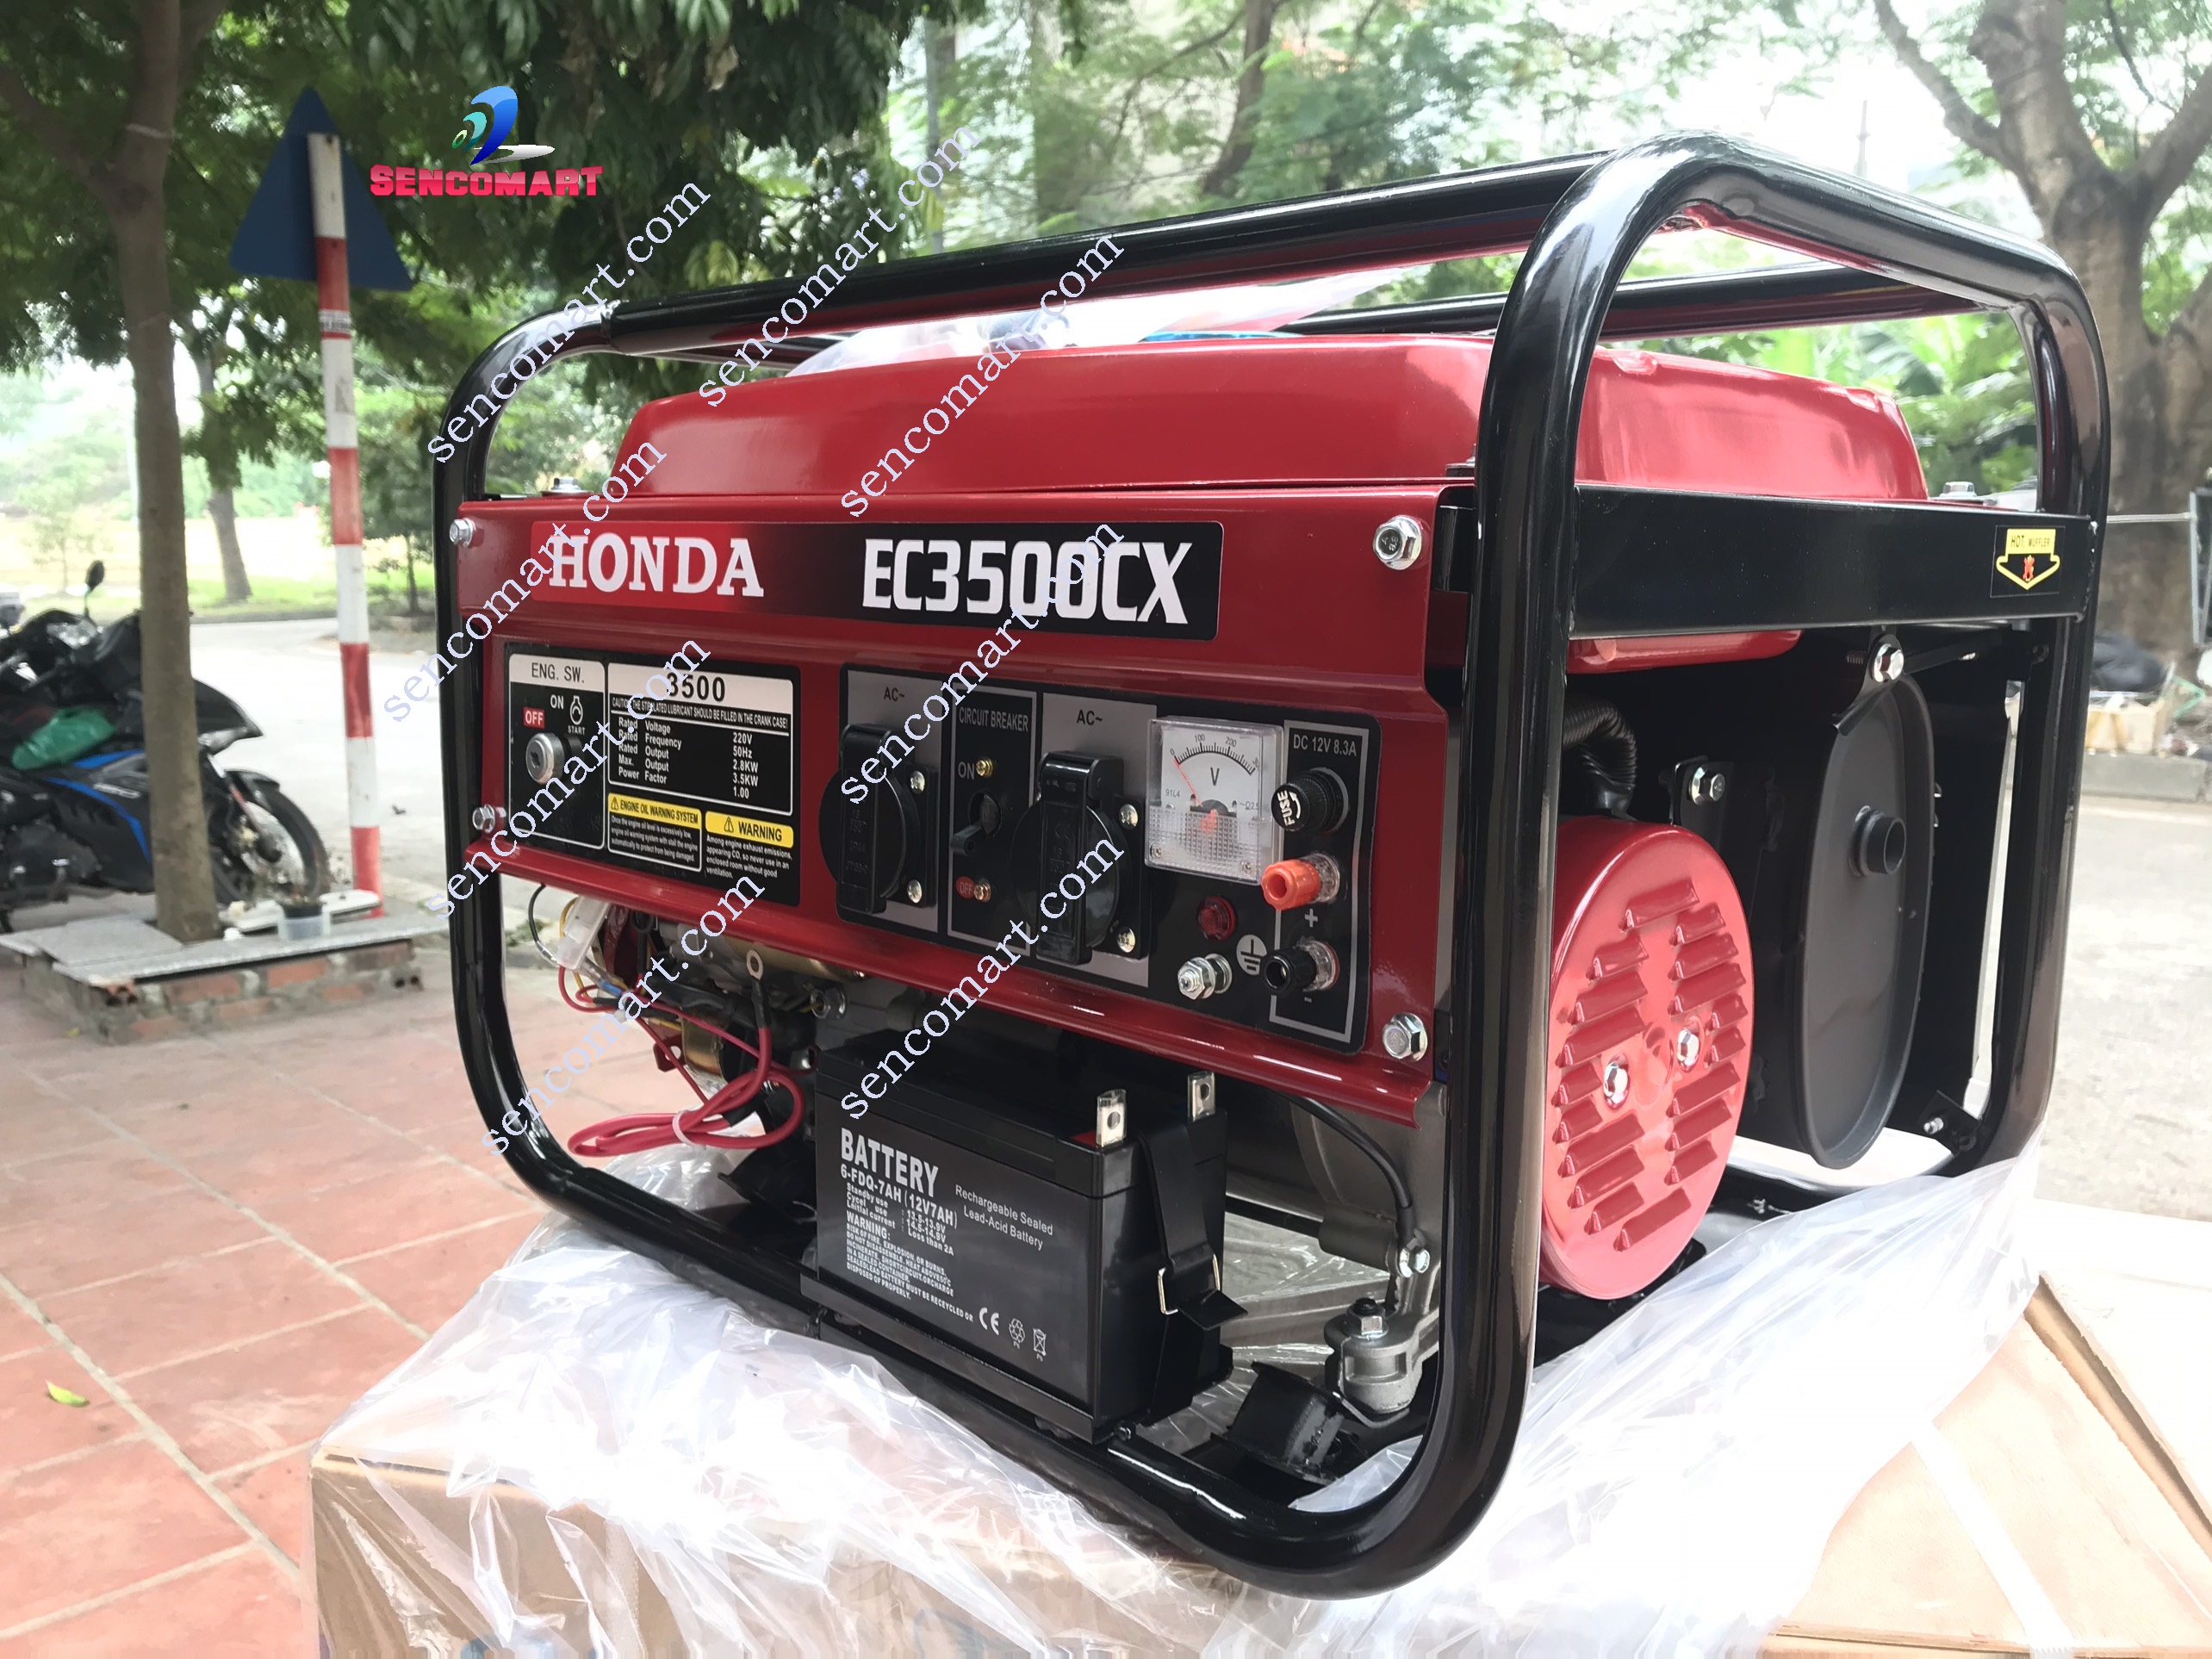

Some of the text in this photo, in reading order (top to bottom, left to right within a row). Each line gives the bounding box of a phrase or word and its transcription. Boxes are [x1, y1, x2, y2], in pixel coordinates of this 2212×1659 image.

[2029, 537, 2051, 548] MUFFLER
[549, 532, 1193, 624] HONDA EC3500CX
[531, 662, 585, 683] ENG. SW.
[667, 672, 725, 702] 3500
[550, 694, 564, 709] ON
[525, 711, 544, 725] OFF
[668, 704, 693, 718] LUBRICANT
[693, 707, 712, 718] SHOULD
[713, 709, 720, 720] BE
[720, 710, 737, 722] FILLED
[737, 711, 743, 723] IN
[743, 712, 753, 724] THE
[754, 714, 772, 727] CRANK
[959, 707, 1028, 732] CIRCUIT BREAKER
[567, 725, 586, 735] START
[618, 717, 753, 745] Rated Voltage 220V
[1194, 734, 1206, 743] 100
[1225, 736, 1237, 747] 200
[618, 730, 753, 760] Rated Frequency 50Hz
[1293, 734, 1357, 756] DC 12V 8.3A
[618, 743, 759, 774] Rated Output 2.8KW
[618, 753, 759, 787] Max. Output 3.5KW
[958, 761, 975, 780] ON
[618, 766, 749, 799] Power Factor 1.00
[1210, 767, 1220, 786] V
[1165, 789, 1181, 798] 91L4
[620, 799, 699, 824] ENGINE OIL WARNING SYSTEM
[1277, 790, 1296, 826] FUSE
[706, 834, 724, 845] Among
[725, 839, 743, 849] engine
[743, 842, 764, 854] exhaust
[738, 821, 783, 842] WARNING
[706, 846, 731, 859] appearing
[749, 854, 765, 864] never
[765, 858, 775, 867] use
[706, 856, 730, 867] enclosed
[743, 863, 763, 875] without
[763, 868, 778, 879] good
[960, 882, 972, 896] OFF
[841, 1127, 939, 1198] BATTERY
[840, 1163, 902, 1203] 6-FDQ-7AH
[847, 1182, 946, 1233] Standby use 13.5-13.9V
[847, 1190, 947, 1243] Cycel use 14.5-14.9V
[955, 1184, 1053, 1236] Rechargeable Sealed
[847, 1209, 891, 1240] WARNING:
[869, 1210, 896, 1229] current
[908, 1227, 925, 1242] Loss
[926, 1235, 942, 1251] than
[944, 1243, 954, 1256] 2A
[963, 1205, 1043, 1251] Lead-Acid Battery
[847, 1222, 860, 1235] RISK
[860, 1229, 867, 1239] OF
[916, 1255, 924, 1266] OR
[847, 1230, 854, 1240] DO
[854, 1234, 866, 1246] NOT
[905, 1258, 921, 1271] HEAT
[847, 1246, 853, 1255] IN
[857, 1252, 878, 1267] SEALED
[847, 1261, 873, 1281] DISPOSED
[873, 1275, 881, 1285] OF
[880, 1270, 905, 1289] BATTERY
[905, 1283, 922, 1296] MUST
[922, 1289, 930, 1302] BE
[930, 1294, 964, 1318] RECEYCLED
[964, 1311, 973, 1323] OR
[979, 1307, 999, 1336] CE
